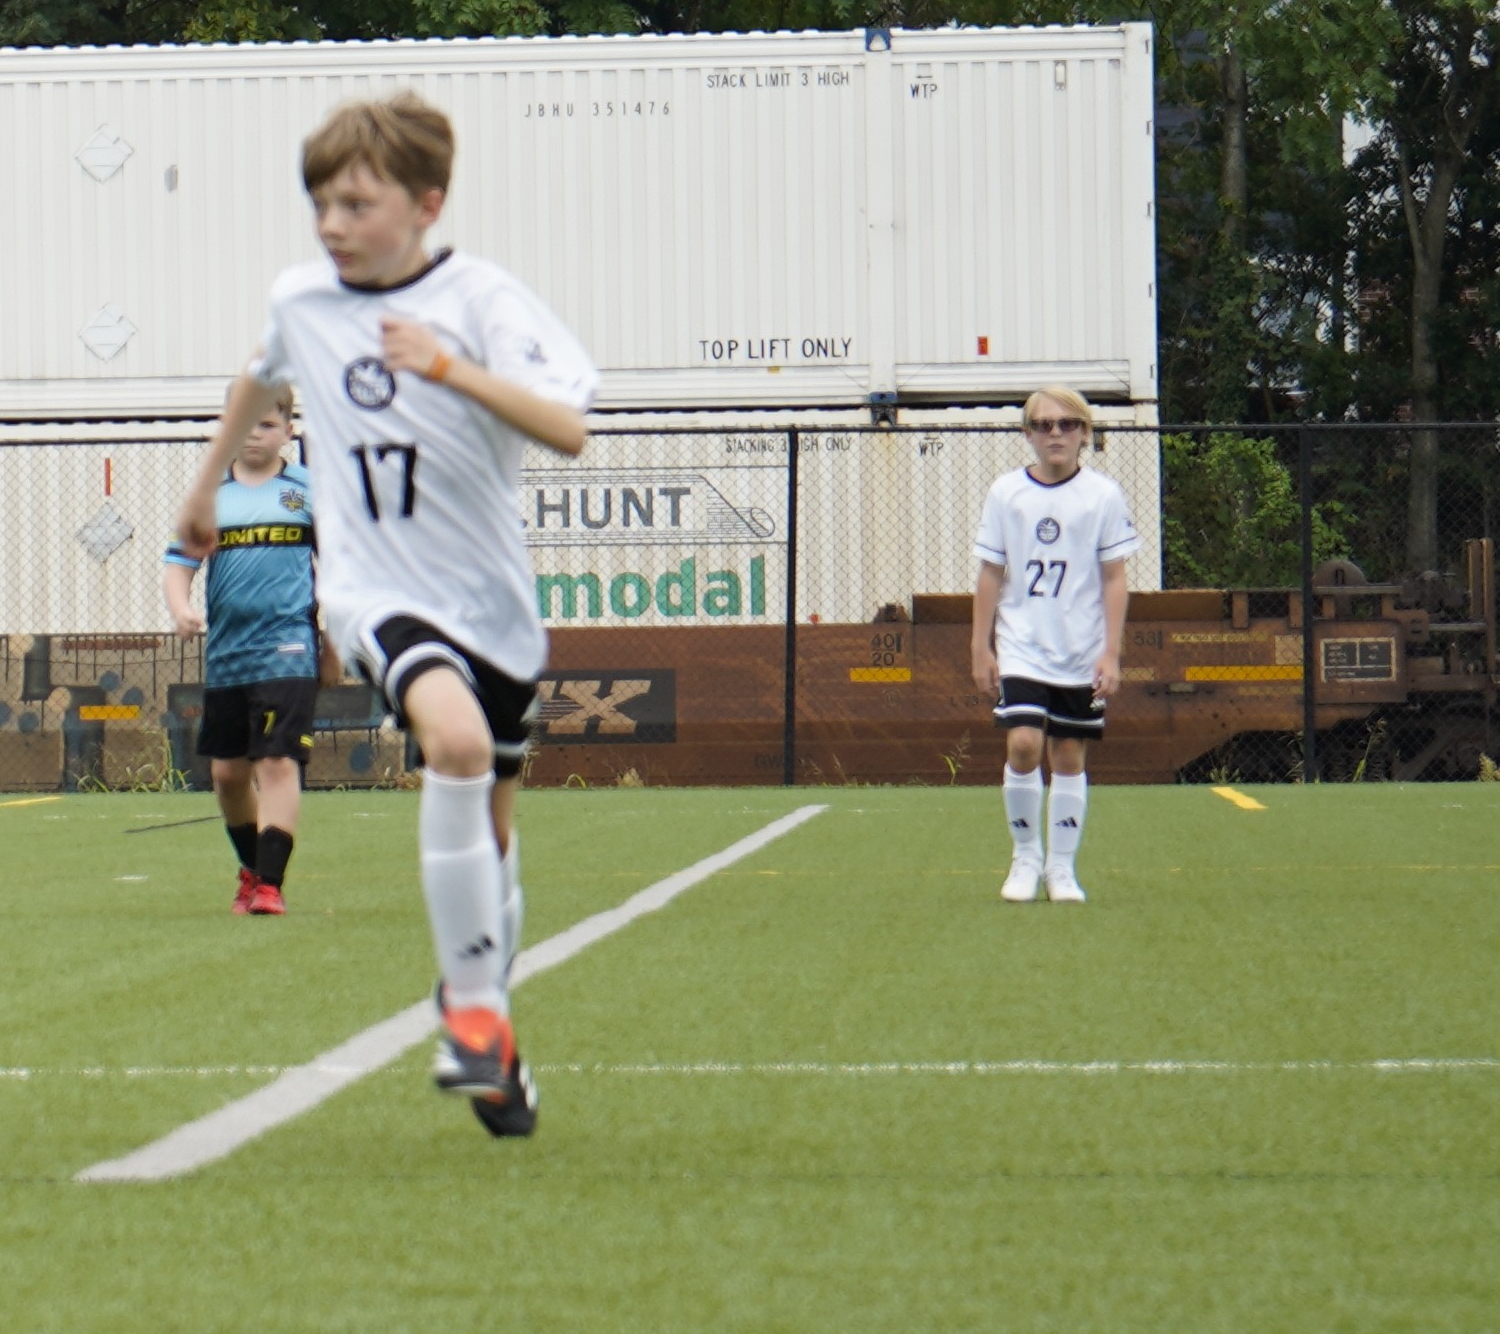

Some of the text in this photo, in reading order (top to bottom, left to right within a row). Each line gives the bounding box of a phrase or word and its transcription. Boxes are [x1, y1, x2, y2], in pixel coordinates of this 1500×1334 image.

[707, 71, 850, 88] STACK LIMIT 3 HIGH
[910, 83, 938, 99] WTP
[524, 101, 671, 117] JBHU 351476
[700, 338, 852, 360] TOP LIFT ONLY
[726, 437, 775, 453] STACKING
[798, 436, 819, 451] IGH
[919, 441, 944, 457] WTP
[350, 442, 417, 523] 17
[1025, 559, 1067, 598] 27
